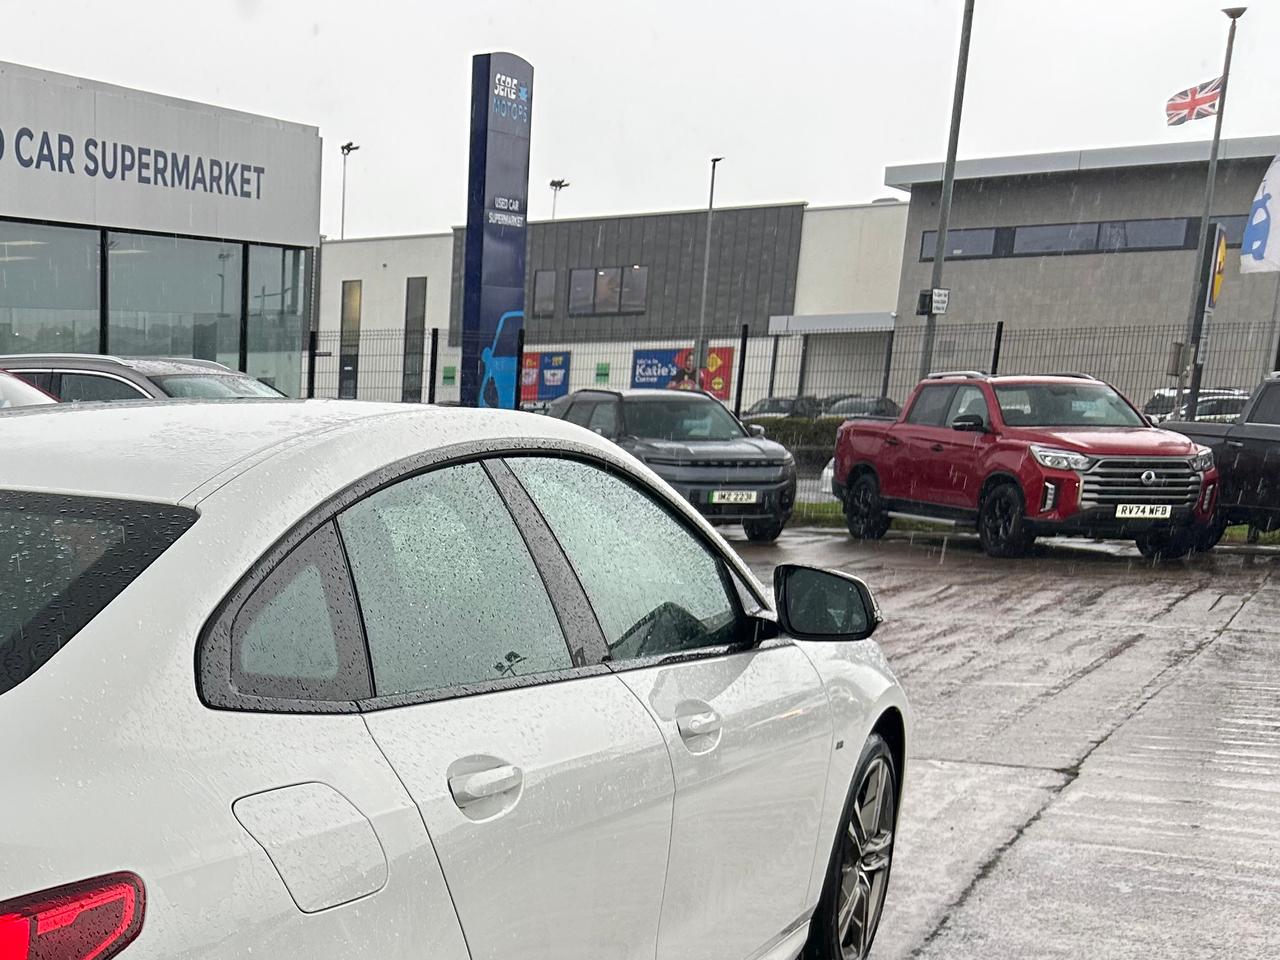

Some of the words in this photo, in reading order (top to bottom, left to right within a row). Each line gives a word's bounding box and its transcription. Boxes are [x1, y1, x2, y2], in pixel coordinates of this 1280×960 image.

[15, 127, 75, 174] CAR
[84, 138, 265, 200] SUPERMARKET
[494, 197, 508, 209] USED
[508, 199, 519, 211] CAR
[488, 212, 524, 227] SUPERMARKET
[636, 363, 677, 377] Katie's
[1121, 505, 1147, 516] RV74
